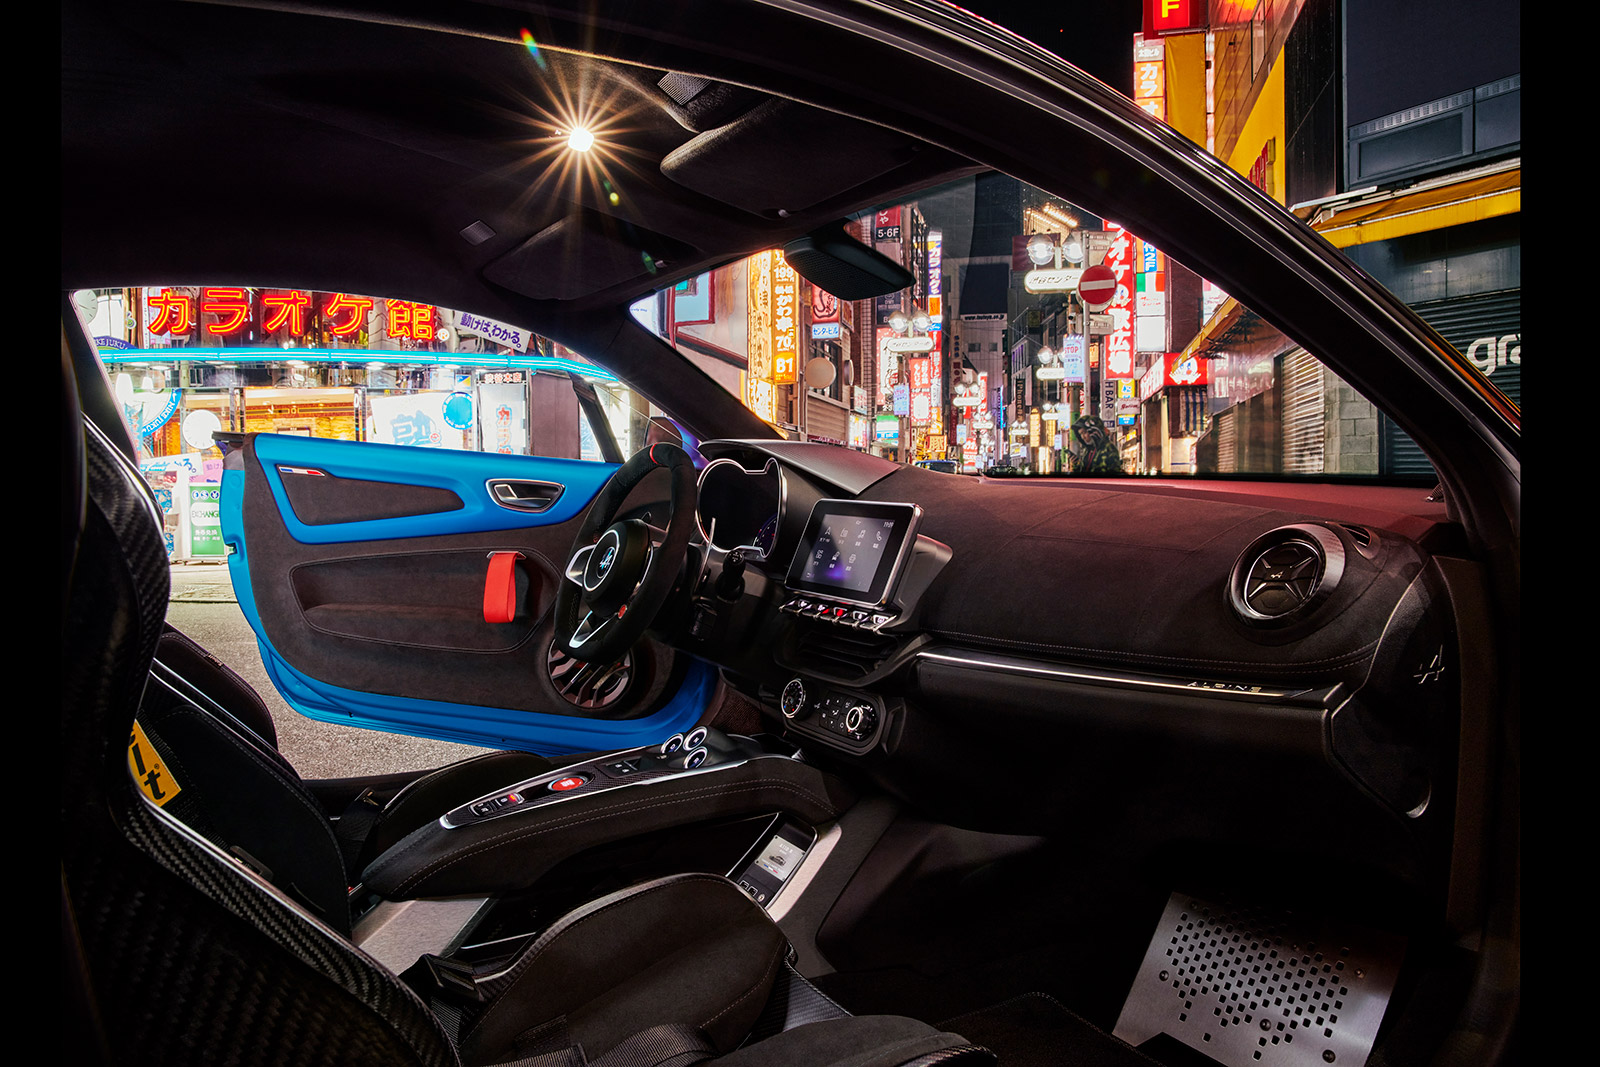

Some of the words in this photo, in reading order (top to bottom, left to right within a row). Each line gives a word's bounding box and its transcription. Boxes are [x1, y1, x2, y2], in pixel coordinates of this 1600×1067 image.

[147, 288, 434, 341] カラオケ館
[776, 358, 793, 373] B1
[1187, 681, 1262, 693] ALPINE
